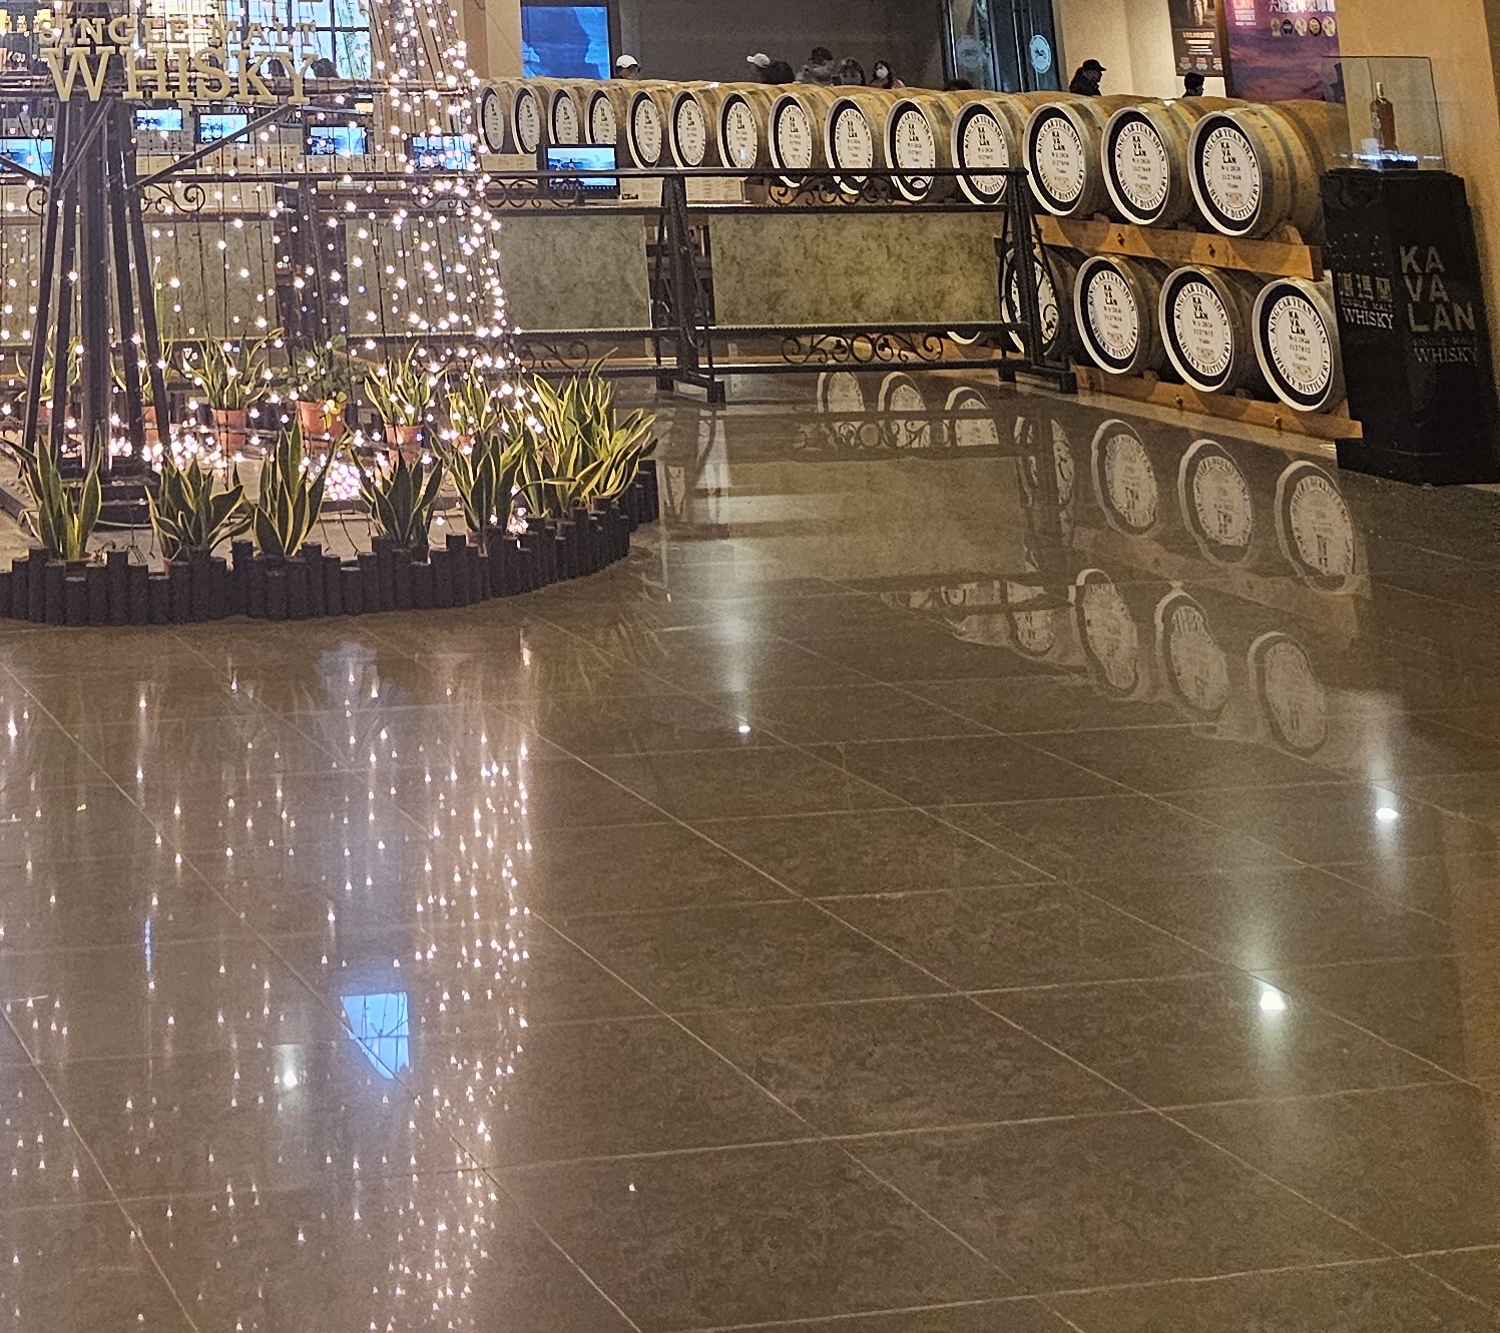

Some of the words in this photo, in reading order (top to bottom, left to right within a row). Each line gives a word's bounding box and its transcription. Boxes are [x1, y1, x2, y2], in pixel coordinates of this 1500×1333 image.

[39, 17, 190, 46] SINGLE
[210, 19, 316, 47] MALT
[40, 45, 319, 105] WHISKY
[1400, 245, 1445, 274] KA
[1403, 274, 1450, 303] VA
[1341, 306, 1394, 330] WHISKY
[1407, 301, 1476, 332] LAN
[1413, 347, 1478, 364] WHISKY
